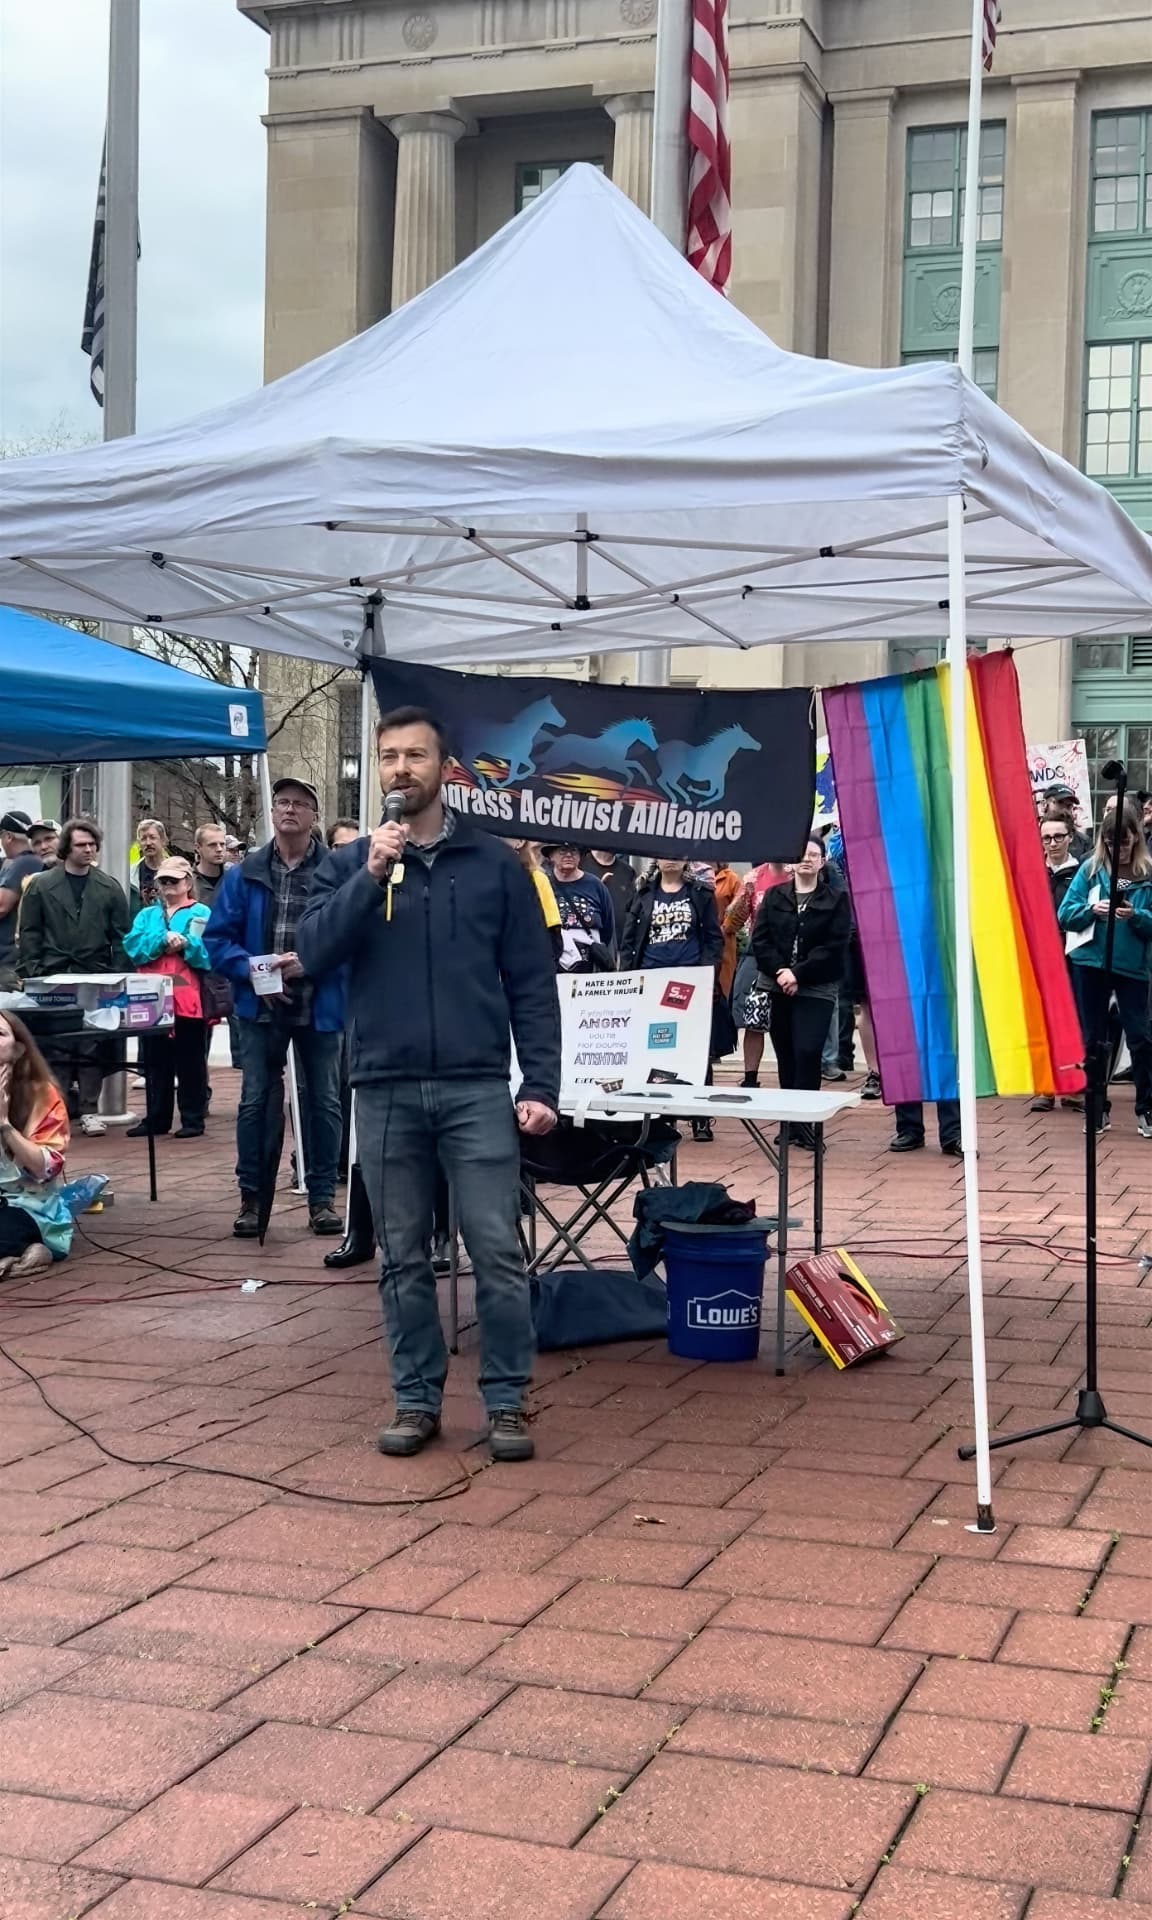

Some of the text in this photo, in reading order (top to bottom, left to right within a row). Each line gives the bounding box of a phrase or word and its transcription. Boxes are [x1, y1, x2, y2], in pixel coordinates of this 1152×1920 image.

[520, 788, 624, 832] Activist
[626, 800, 742, 841] Alliance
[616, 978, 632, 986] NOT
[578, 1018, 632, 1029] ANGRY
